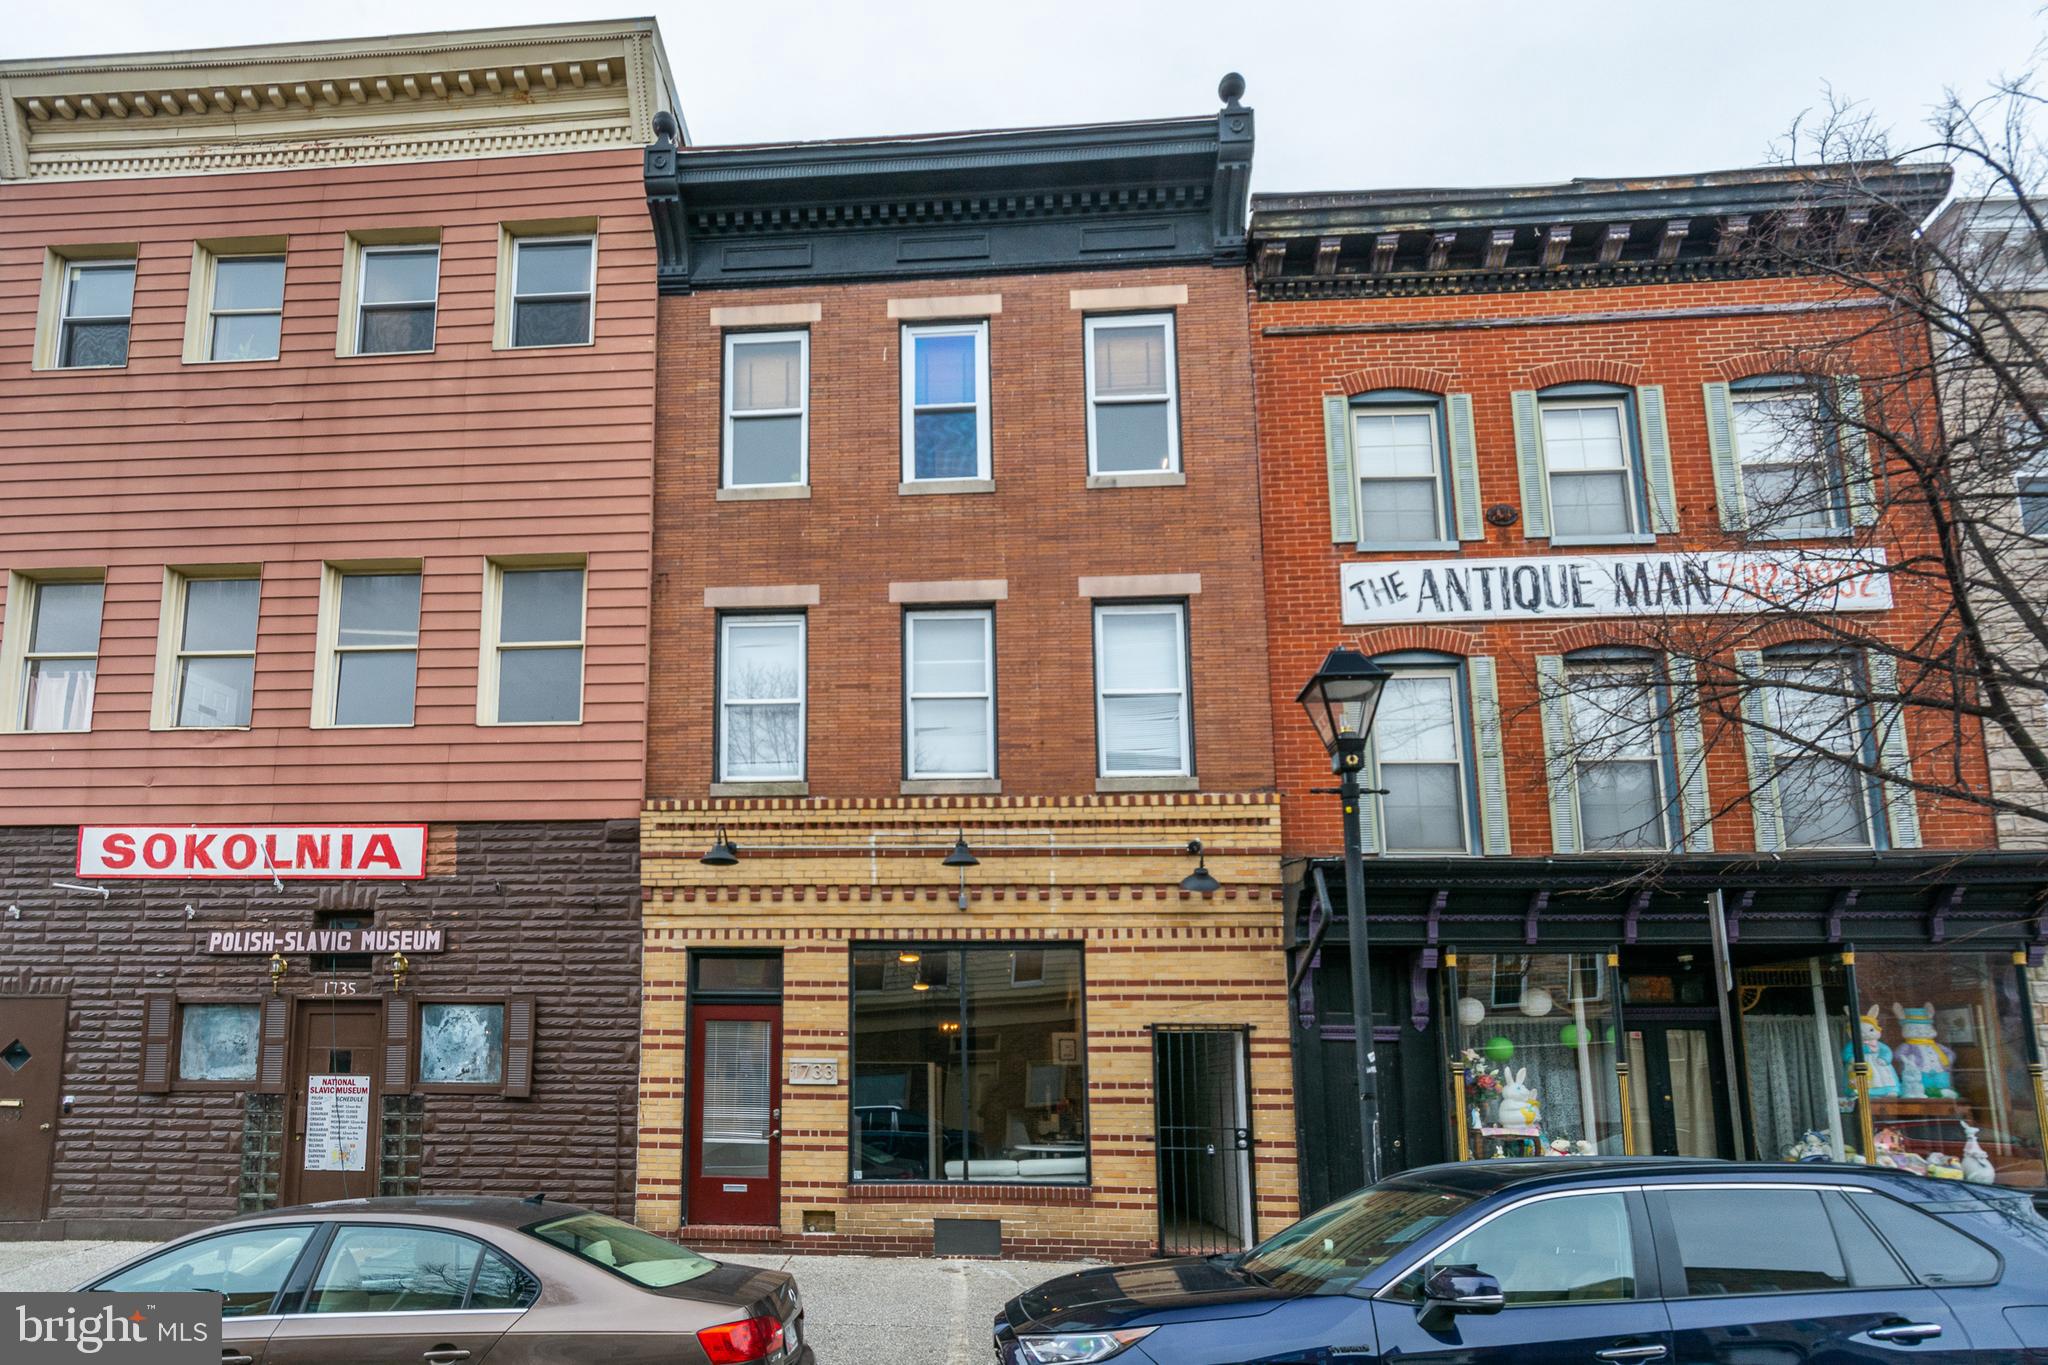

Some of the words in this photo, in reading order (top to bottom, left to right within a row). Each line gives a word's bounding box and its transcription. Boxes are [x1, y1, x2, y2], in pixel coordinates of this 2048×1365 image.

[1349, 570, 1408, 611] THE
[1416, 563, 1594, 613] ANTIQUE
[1614, 560, 1712, 607] MAN
[101, 833, 402, 870] SOKOLNIA
[209, 930, 351, 952] POLISH-SLAVIC
[361, 929, 442, 951] MUSEUM
[324, 981, 357, 995] 1735
[791, 1063, 834, 1080] 1733
[310, 1086, 335, 1094] SLAVIC
[336, 1086, 368, 1094] MUSEUM
[322, 1078, 356, 1086] NATIONAL
